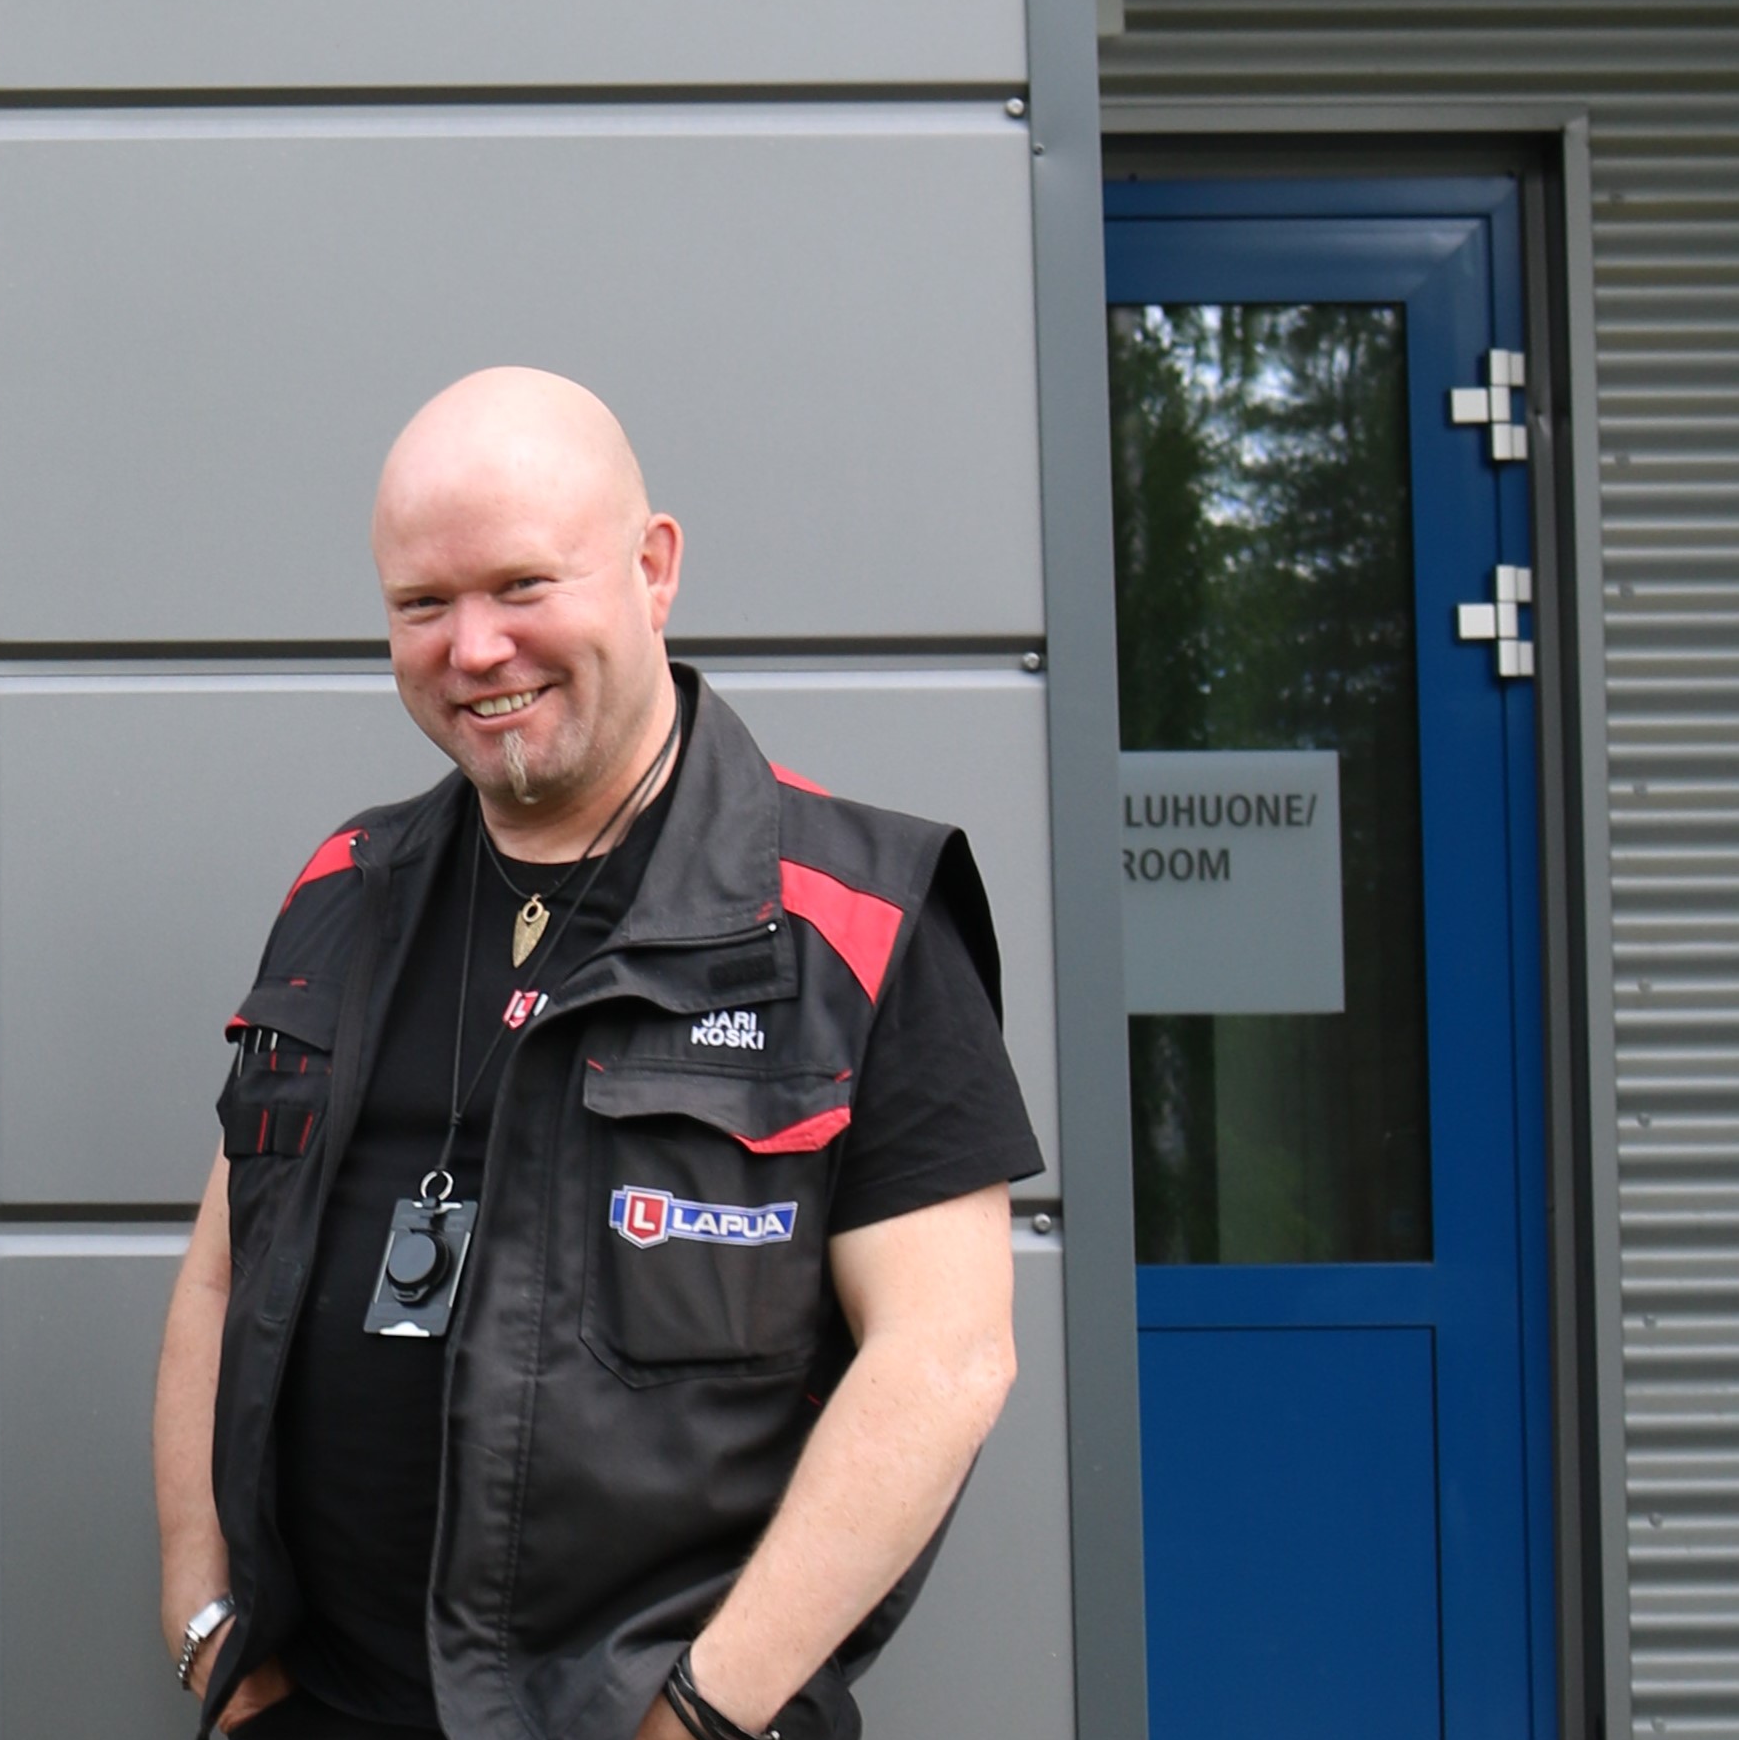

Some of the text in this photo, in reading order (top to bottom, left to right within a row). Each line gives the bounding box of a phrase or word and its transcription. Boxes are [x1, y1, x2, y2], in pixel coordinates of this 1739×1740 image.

[700, 1010, 758, 1031] JARI
[690, 1024, 764, 1050] KOSKI
[672, 1207, 786, 1238] LAPUA
